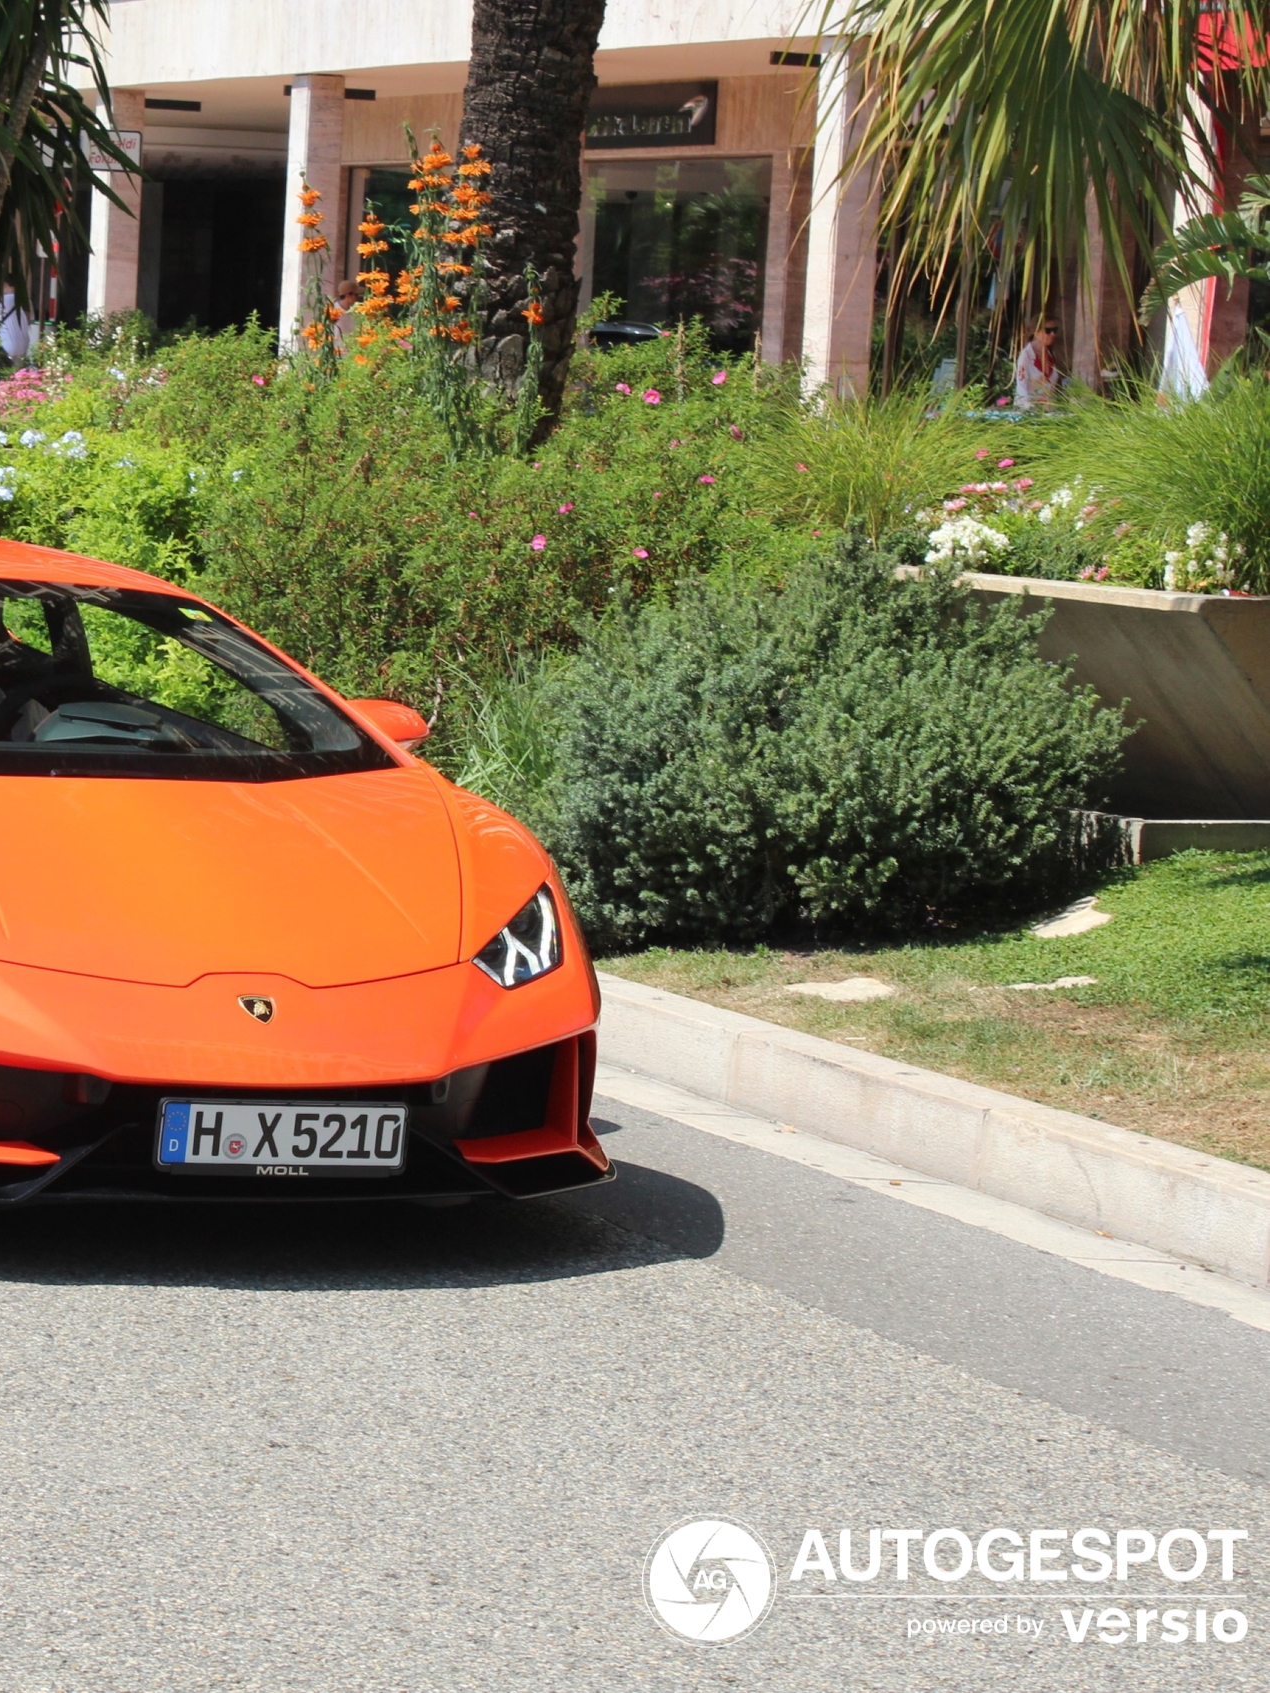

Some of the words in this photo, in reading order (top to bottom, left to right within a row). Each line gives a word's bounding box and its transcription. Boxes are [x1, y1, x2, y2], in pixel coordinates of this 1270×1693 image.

[192, 1111, 223, 1156] H
[168, 1138, 179, 1152] D
[256, 1165, 309, 1176] MOLL
